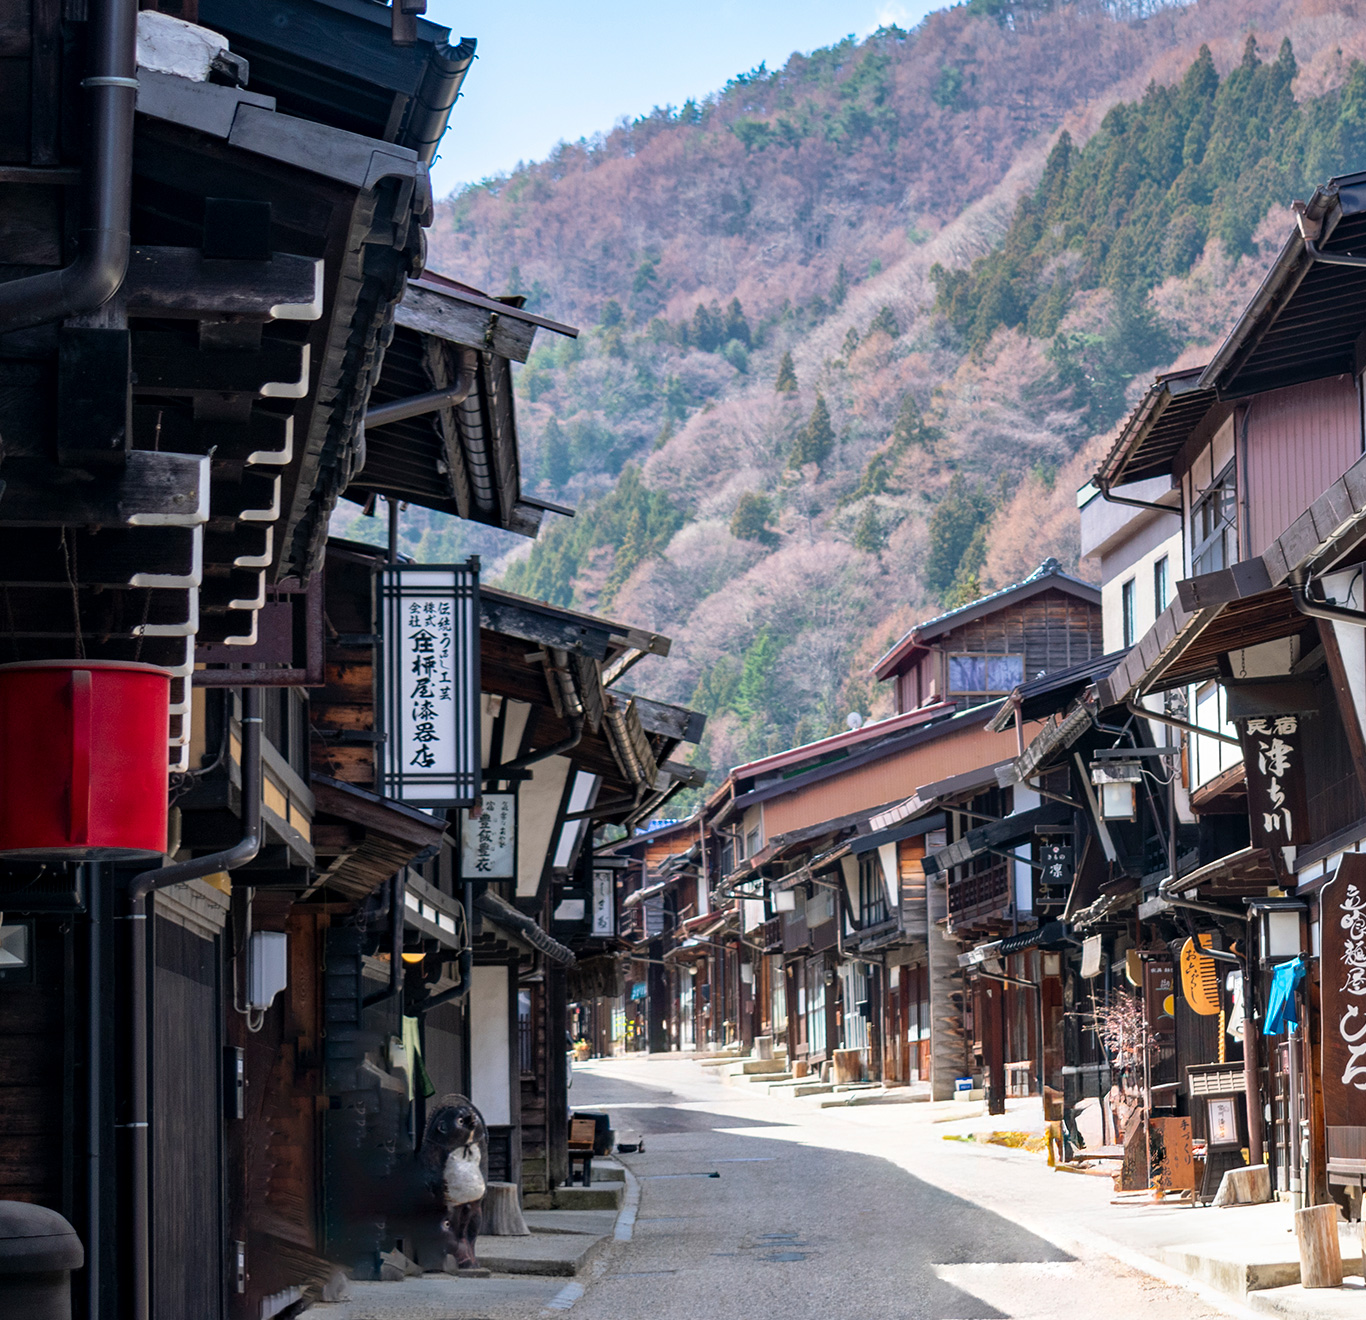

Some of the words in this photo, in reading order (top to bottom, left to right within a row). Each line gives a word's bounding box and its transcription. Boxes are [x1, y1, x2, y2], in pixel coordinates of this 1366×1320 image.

[1246, 716, 1297, 736] 民宿
[1258, 738, 1294, 842] 津ち川
